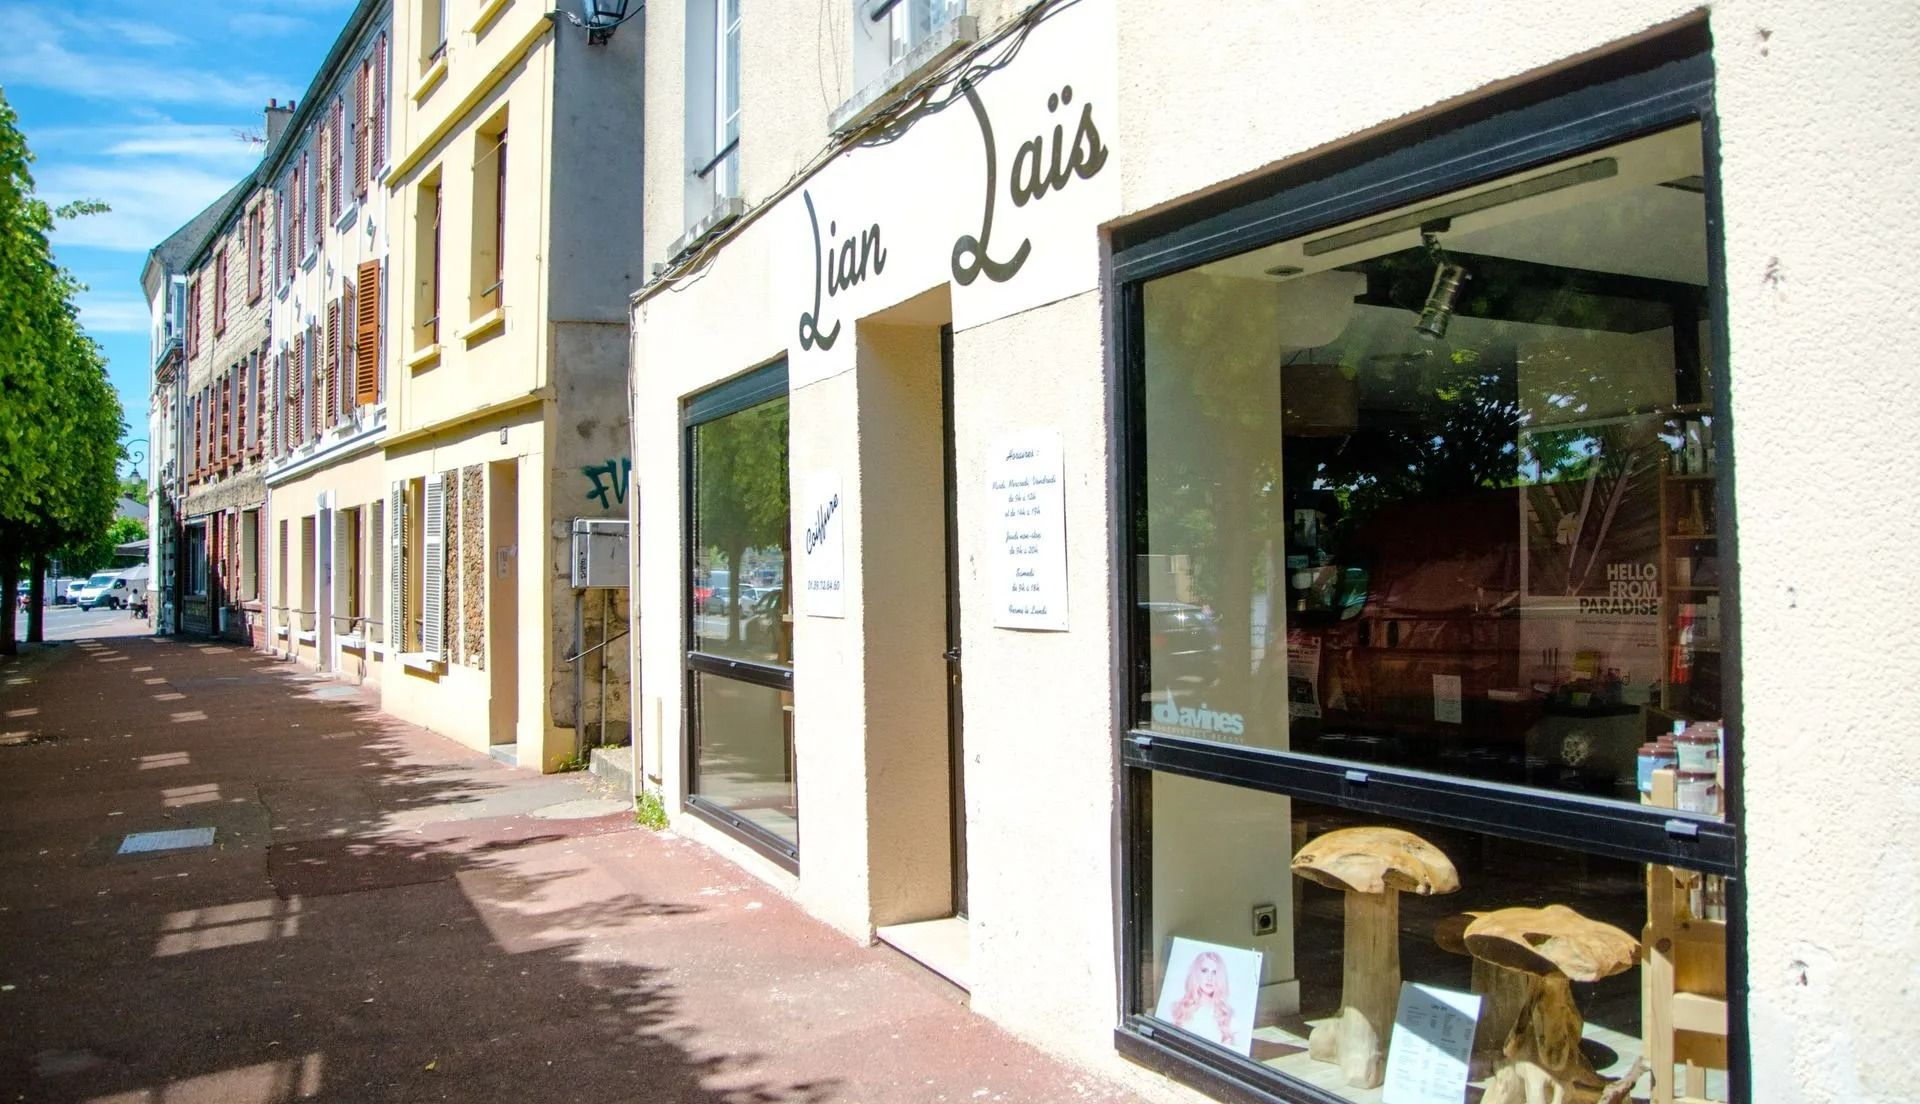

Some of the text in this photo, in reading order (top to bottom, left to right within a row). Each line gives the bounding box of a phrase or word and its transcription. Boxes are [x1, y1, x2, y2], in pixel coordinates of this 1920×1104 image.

[951, 77, 1109, 287] Laïs
[799, 189, 888, 351] Lian
[806, 493, 839, 555] Coiffure
[1015, 567, 1035, 577] Samedi
[1606, 563, 1657, 580] HELLO
[1609, 581, 1657, 598] FROM
[1580, 598, 1658, 615] PARADISE
[1153, 686, 1244, 735] davines
